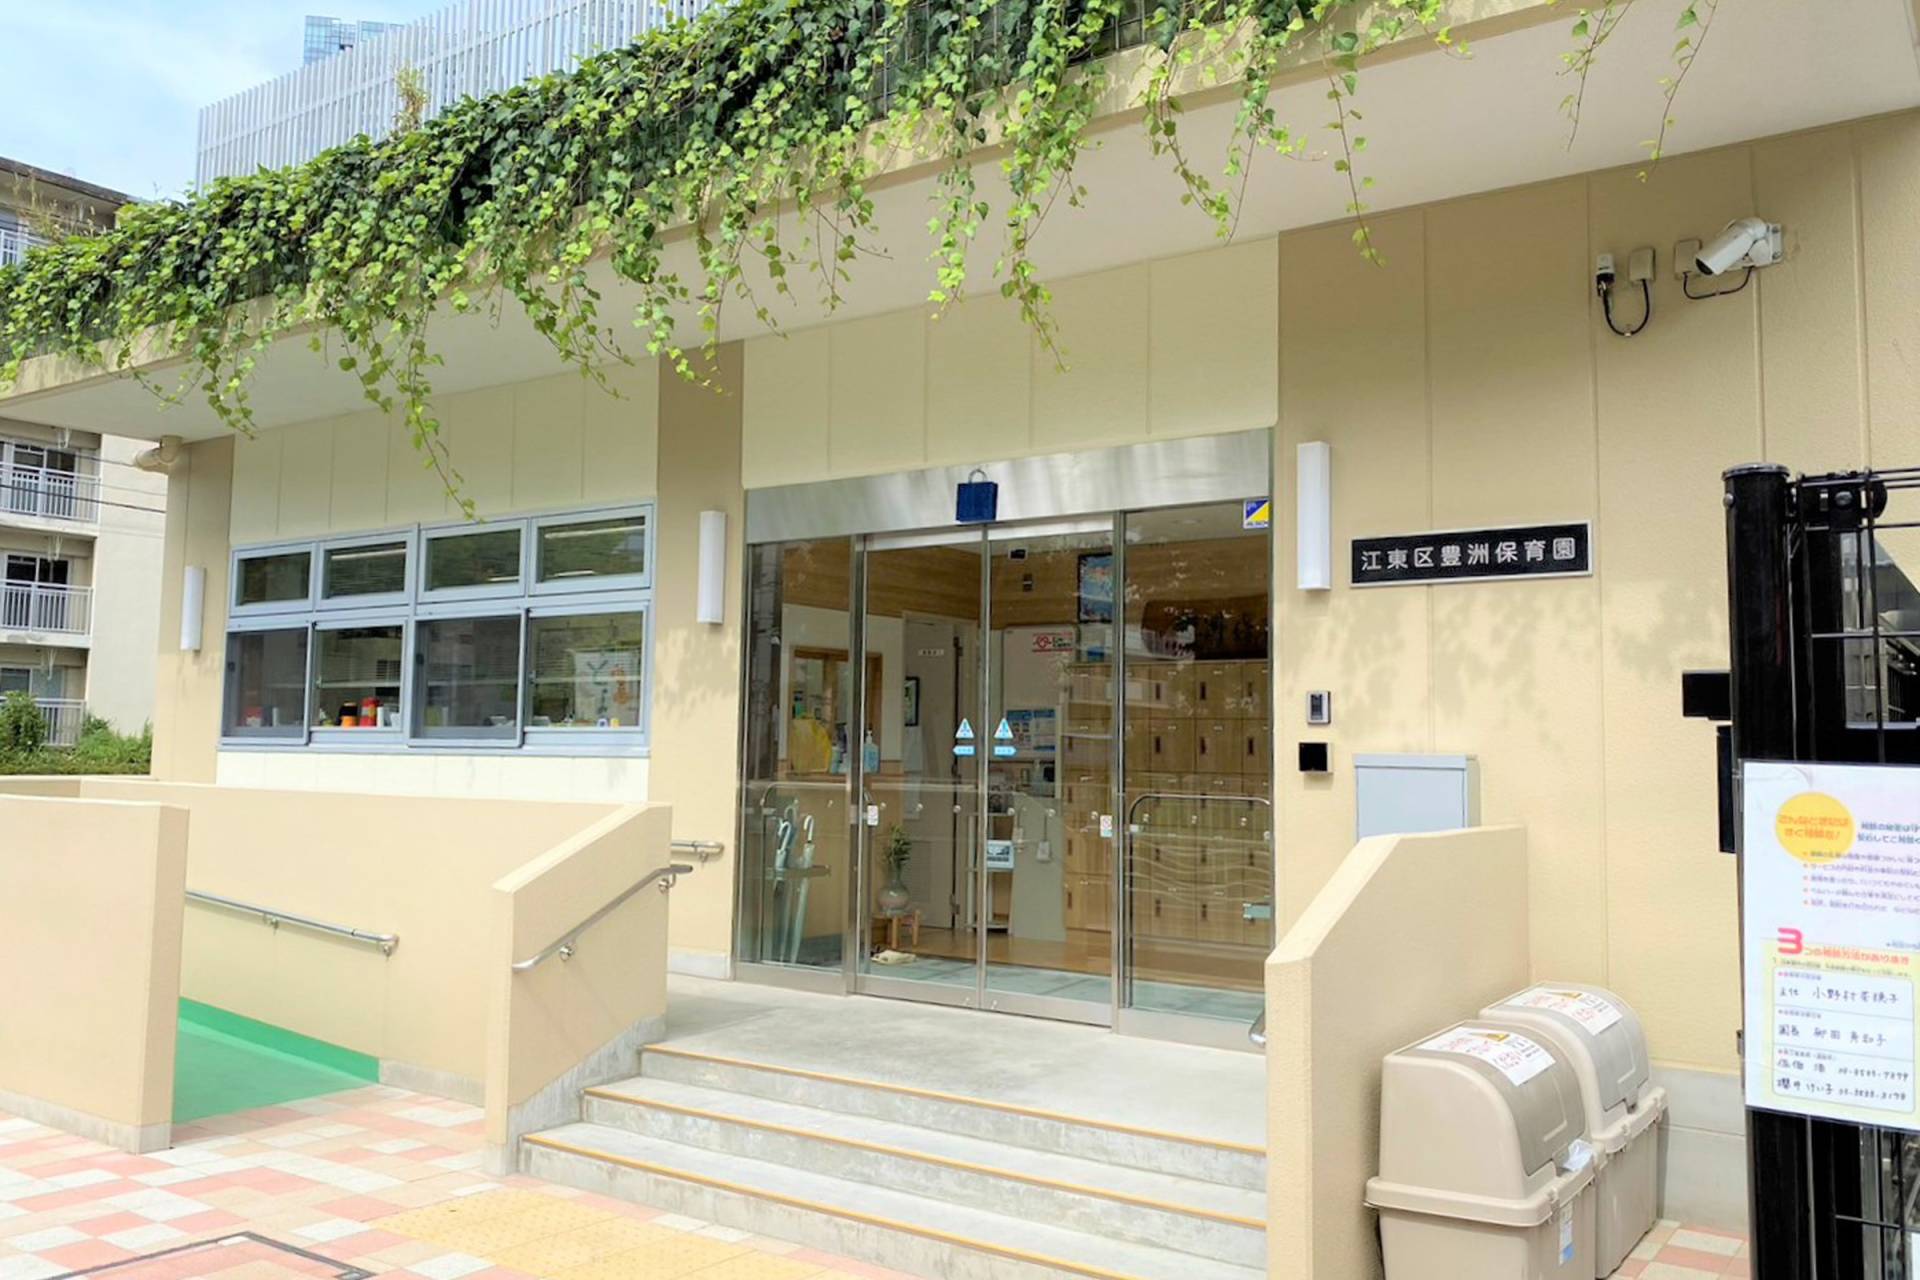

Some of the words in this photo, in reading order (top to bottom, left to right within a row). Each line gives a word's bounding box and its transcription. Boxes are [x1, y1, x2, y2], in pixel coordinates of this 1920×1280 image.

[1361, 537, 1576, 571] 江東区豊洲保育園
